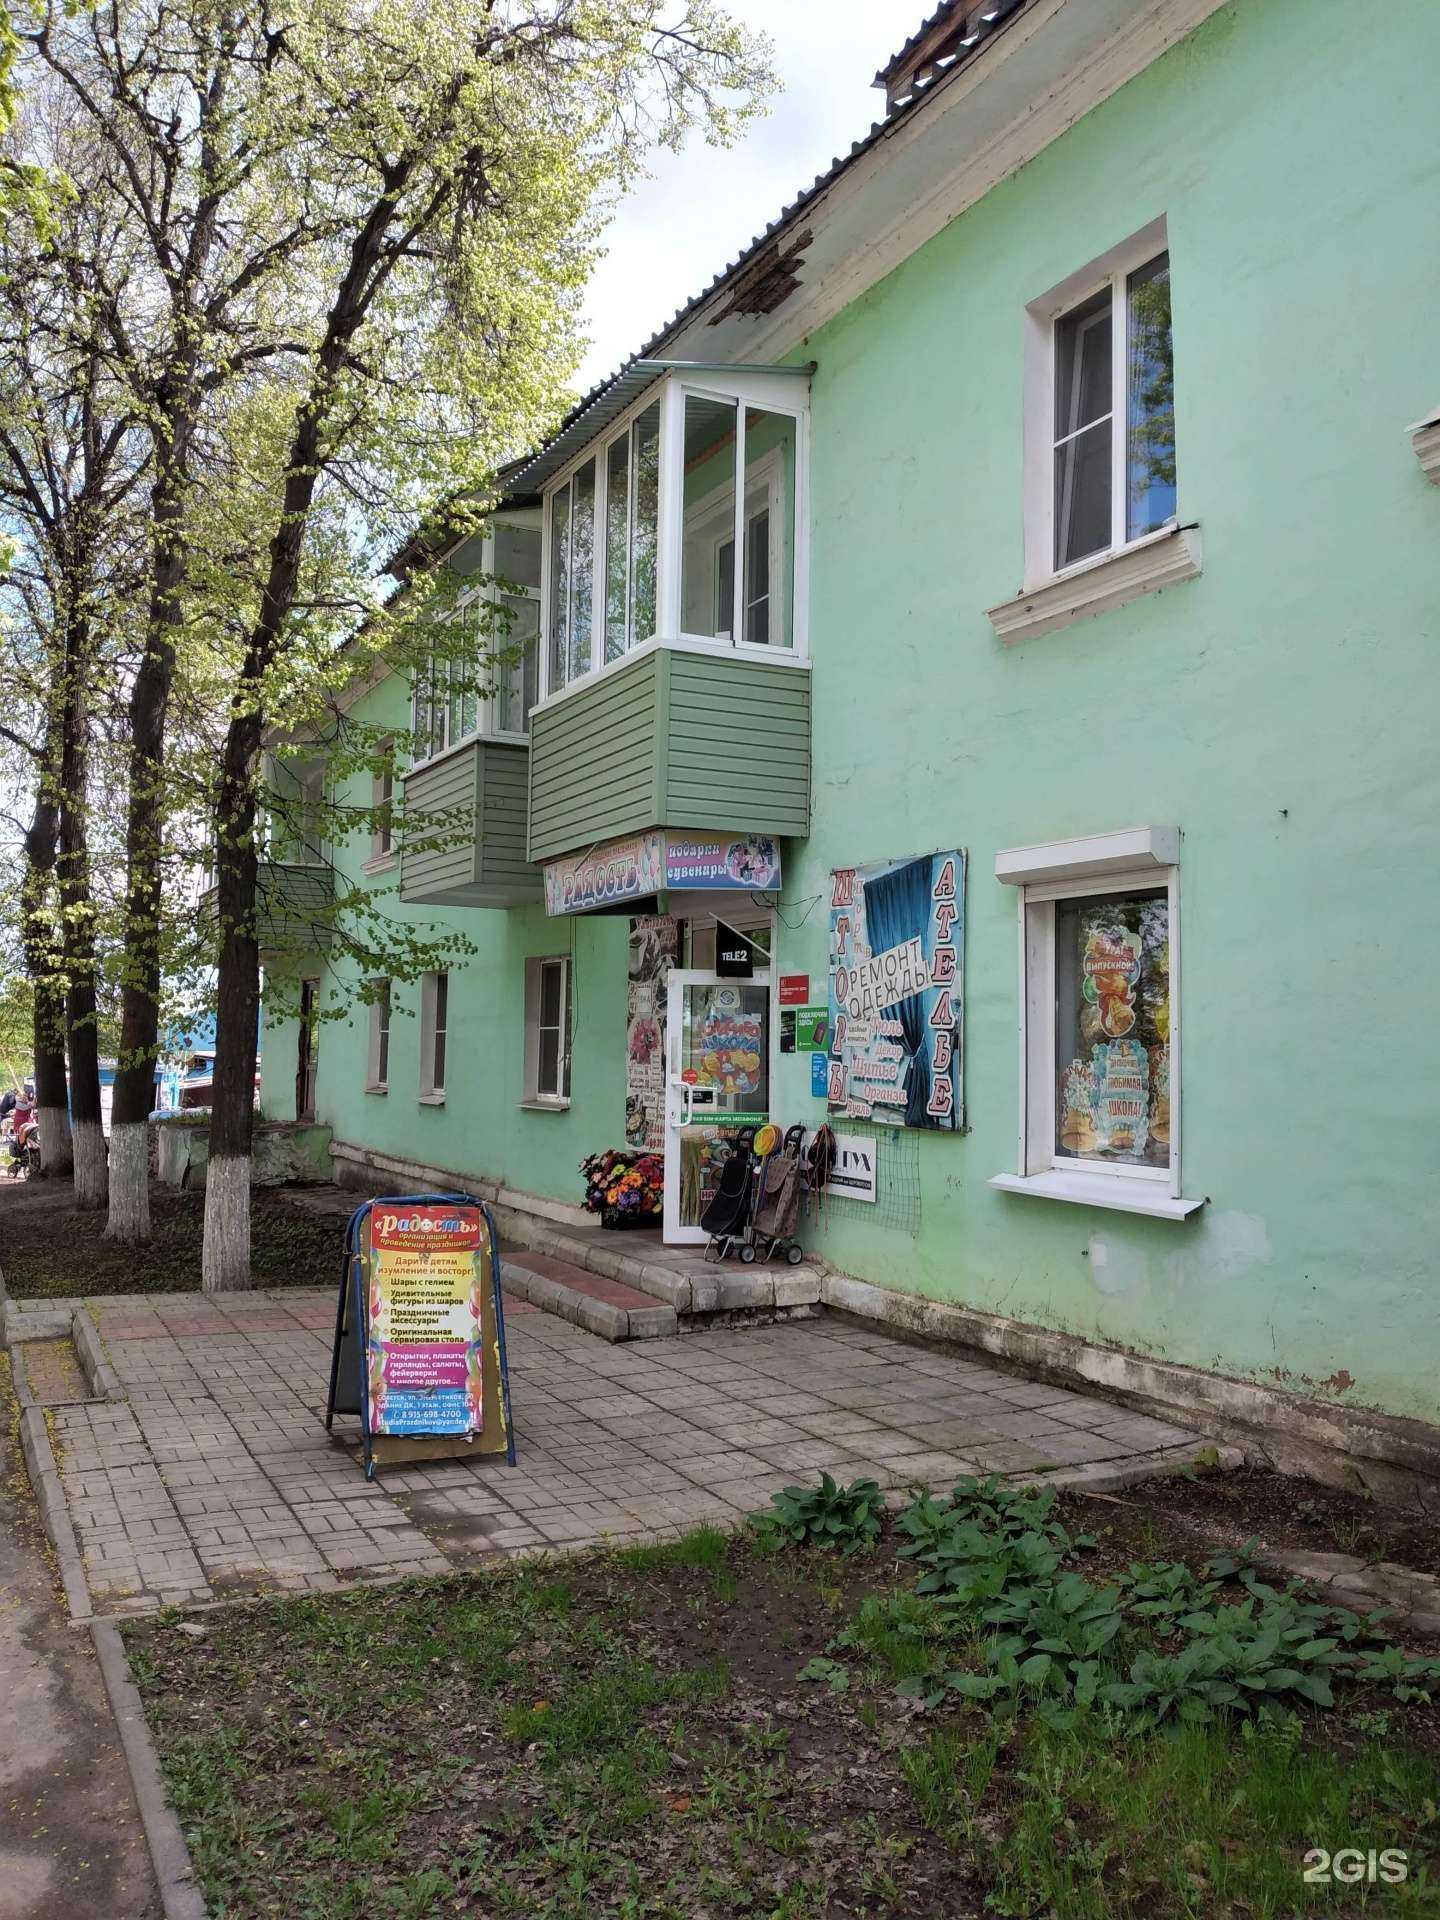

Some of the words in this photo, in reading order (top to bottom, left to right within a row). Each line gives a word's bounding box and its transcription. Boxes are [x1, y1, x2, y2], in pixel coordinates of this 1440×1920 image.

[668, 840, 721, 861] подарки
[667, 863, 728, 882] сувениры
[563, 857, 638, 906] РАДОСТЬ
[721, 950, 748, 962] TELE2
[849, 939, 920, 992] РЕМОНТ
[828, 868, 856, 1103] ШТОРЫ
[849, 959, 931, 1019] ОДЕЖДЫ
[927, 860, 957, 1114] АТЕЛЬЕ
[399, 1233, 447, 1241] организация
[380, 1238, 426, 1248] проведение
[394, 1256, 428, 1266] Дарите
[430, 1258, 458, 1266] детям
[378, 1267, 428, 1277] изумление
[437, 1267, 474, 1277] восторг!
[390, 1279, 417, 1288] Шары
[390, 1289, 452, 1298] Удивительные
[390, 1298, 425, 1306] фигуры
[390, 1308, 450, 1317] Праздничные
[390, 1318, 439, 1326] аксессуары
[390, 1328, 452, 1336] Оригинальная
[390, 1337, 440, 1345] сервировка
[389, 1370, 438, 1378] фейерверки
